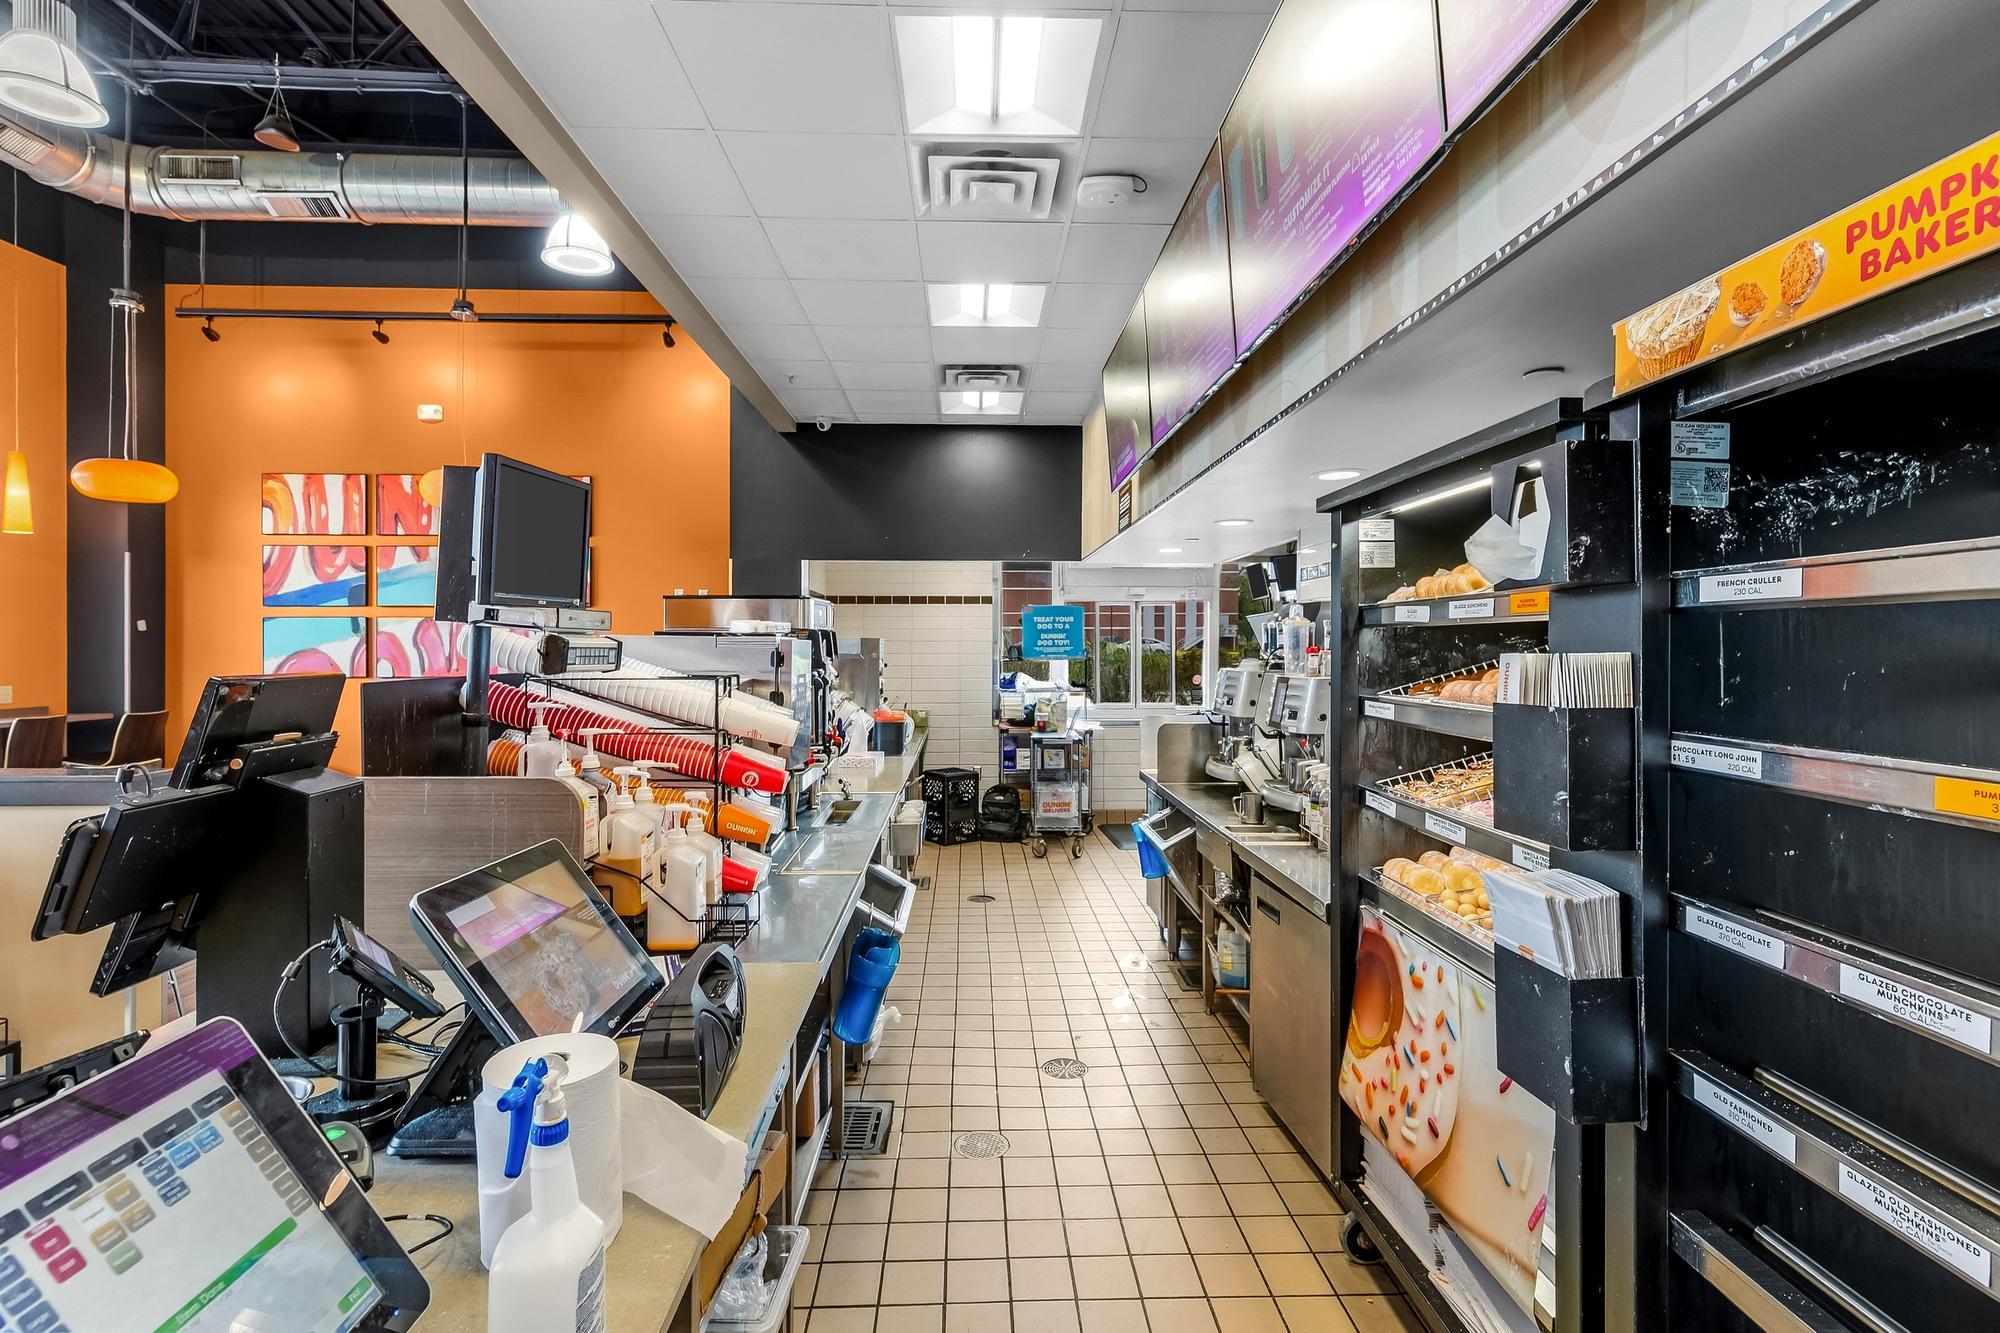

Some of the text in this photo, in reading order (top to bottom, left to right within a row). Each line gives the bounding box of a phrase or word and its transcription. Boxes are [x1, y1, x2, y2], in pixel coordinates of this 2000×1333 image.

[1283, 172, 1322, 232] CUSTOMIZE
[1322, 160, 1331, 182] IT
[1846, 154, 2000, 254] PUMPK
[1860, 195, 2000, 282] BAKER
[1717, 575, 1782, 588] FRENCH CRULLER
[1748, 587, 1763, 595] CAL
[1672, 745, 1757, 764] CHOCOLATE LONG JOHN
[1728, 763, 1756, 774] 320 CAL
[1974, 789, 2000, 800] PUM
[1696, 915, 1772, 949] GLAZED CHOCOLATE
[1718, 932, 1746, 949] 370 CAL
[1858, 972, 1973, 1023] GLAZED CHOCOLATE
[1893, 1004, 1907, 1016] 60
[1908, 1011, 1931, 1027] CAL
[1713, 1091, 1773, 1133] OLD FASHIONED
[1740, 1117, 1756, 1133] CAL
[1846, 1170, 1886, 1199] GLAZED
[1888, 1196, 1911, 1214] OLD
[1913, 1211, 1981, 1257] FASHIONED
[1890, 1216, 1927, 1246] 70 CAL
